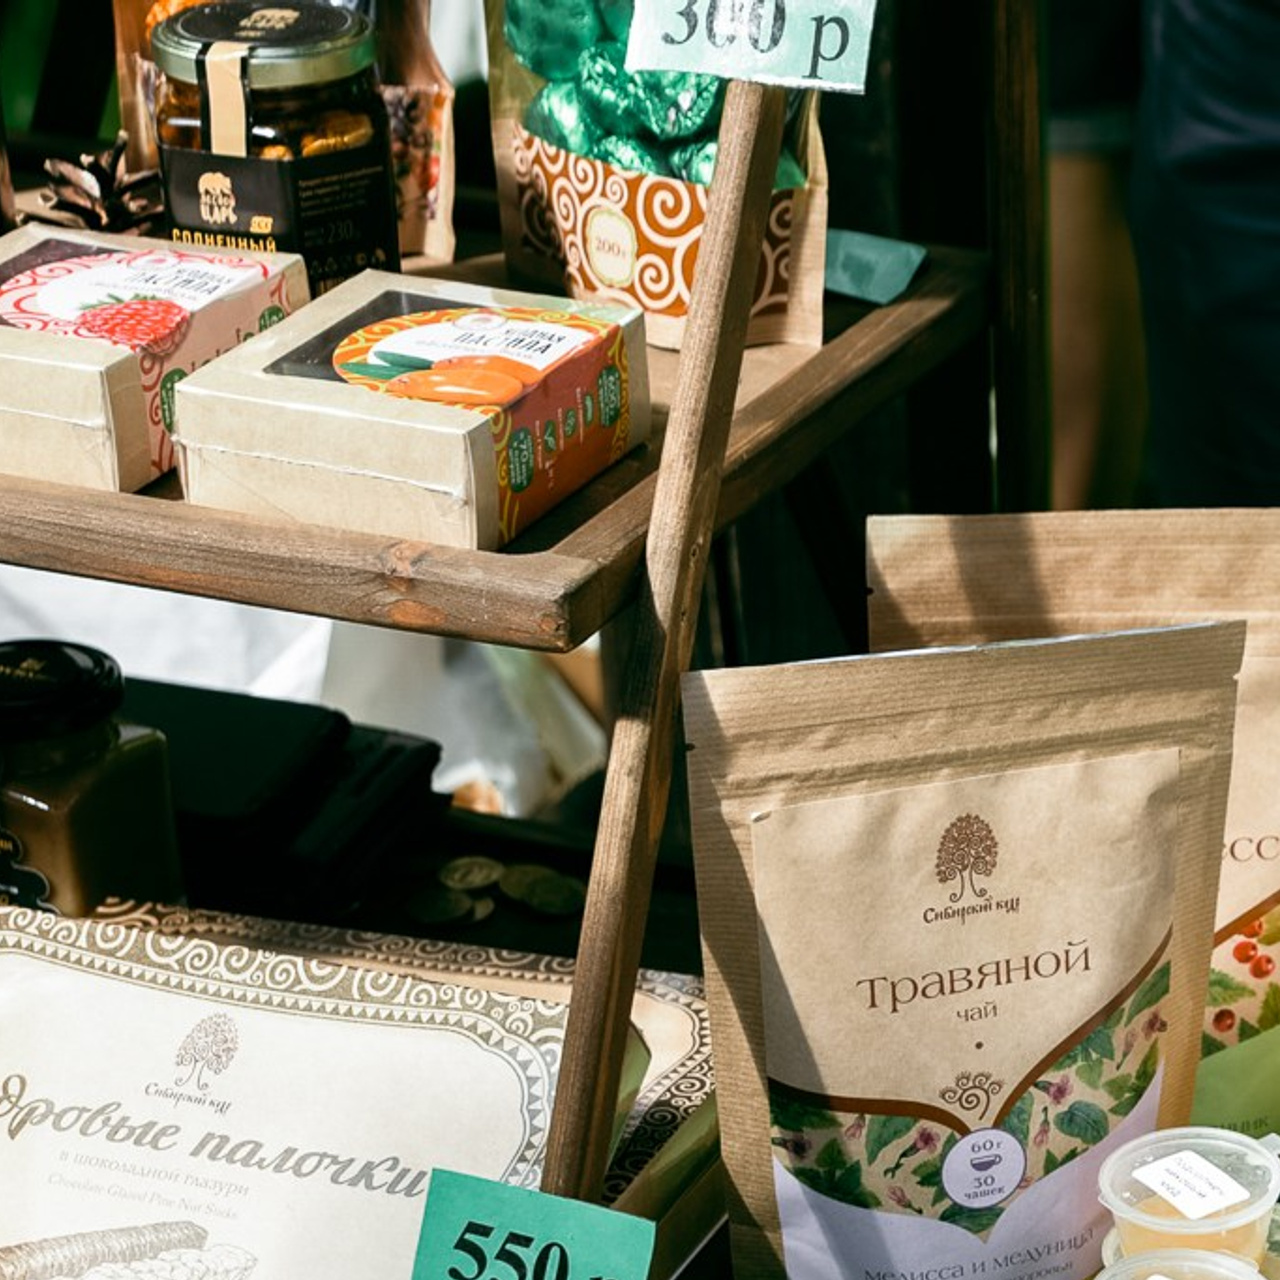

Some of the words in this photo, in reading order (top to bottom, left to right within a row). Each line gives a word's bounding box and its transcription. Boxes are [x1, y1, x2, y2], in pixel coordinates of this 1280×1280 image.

[957, 1001, 998, 1022] чай
[190, 1129, 427, 1198] палочки
[974, 1176, 995, 1189] 30
